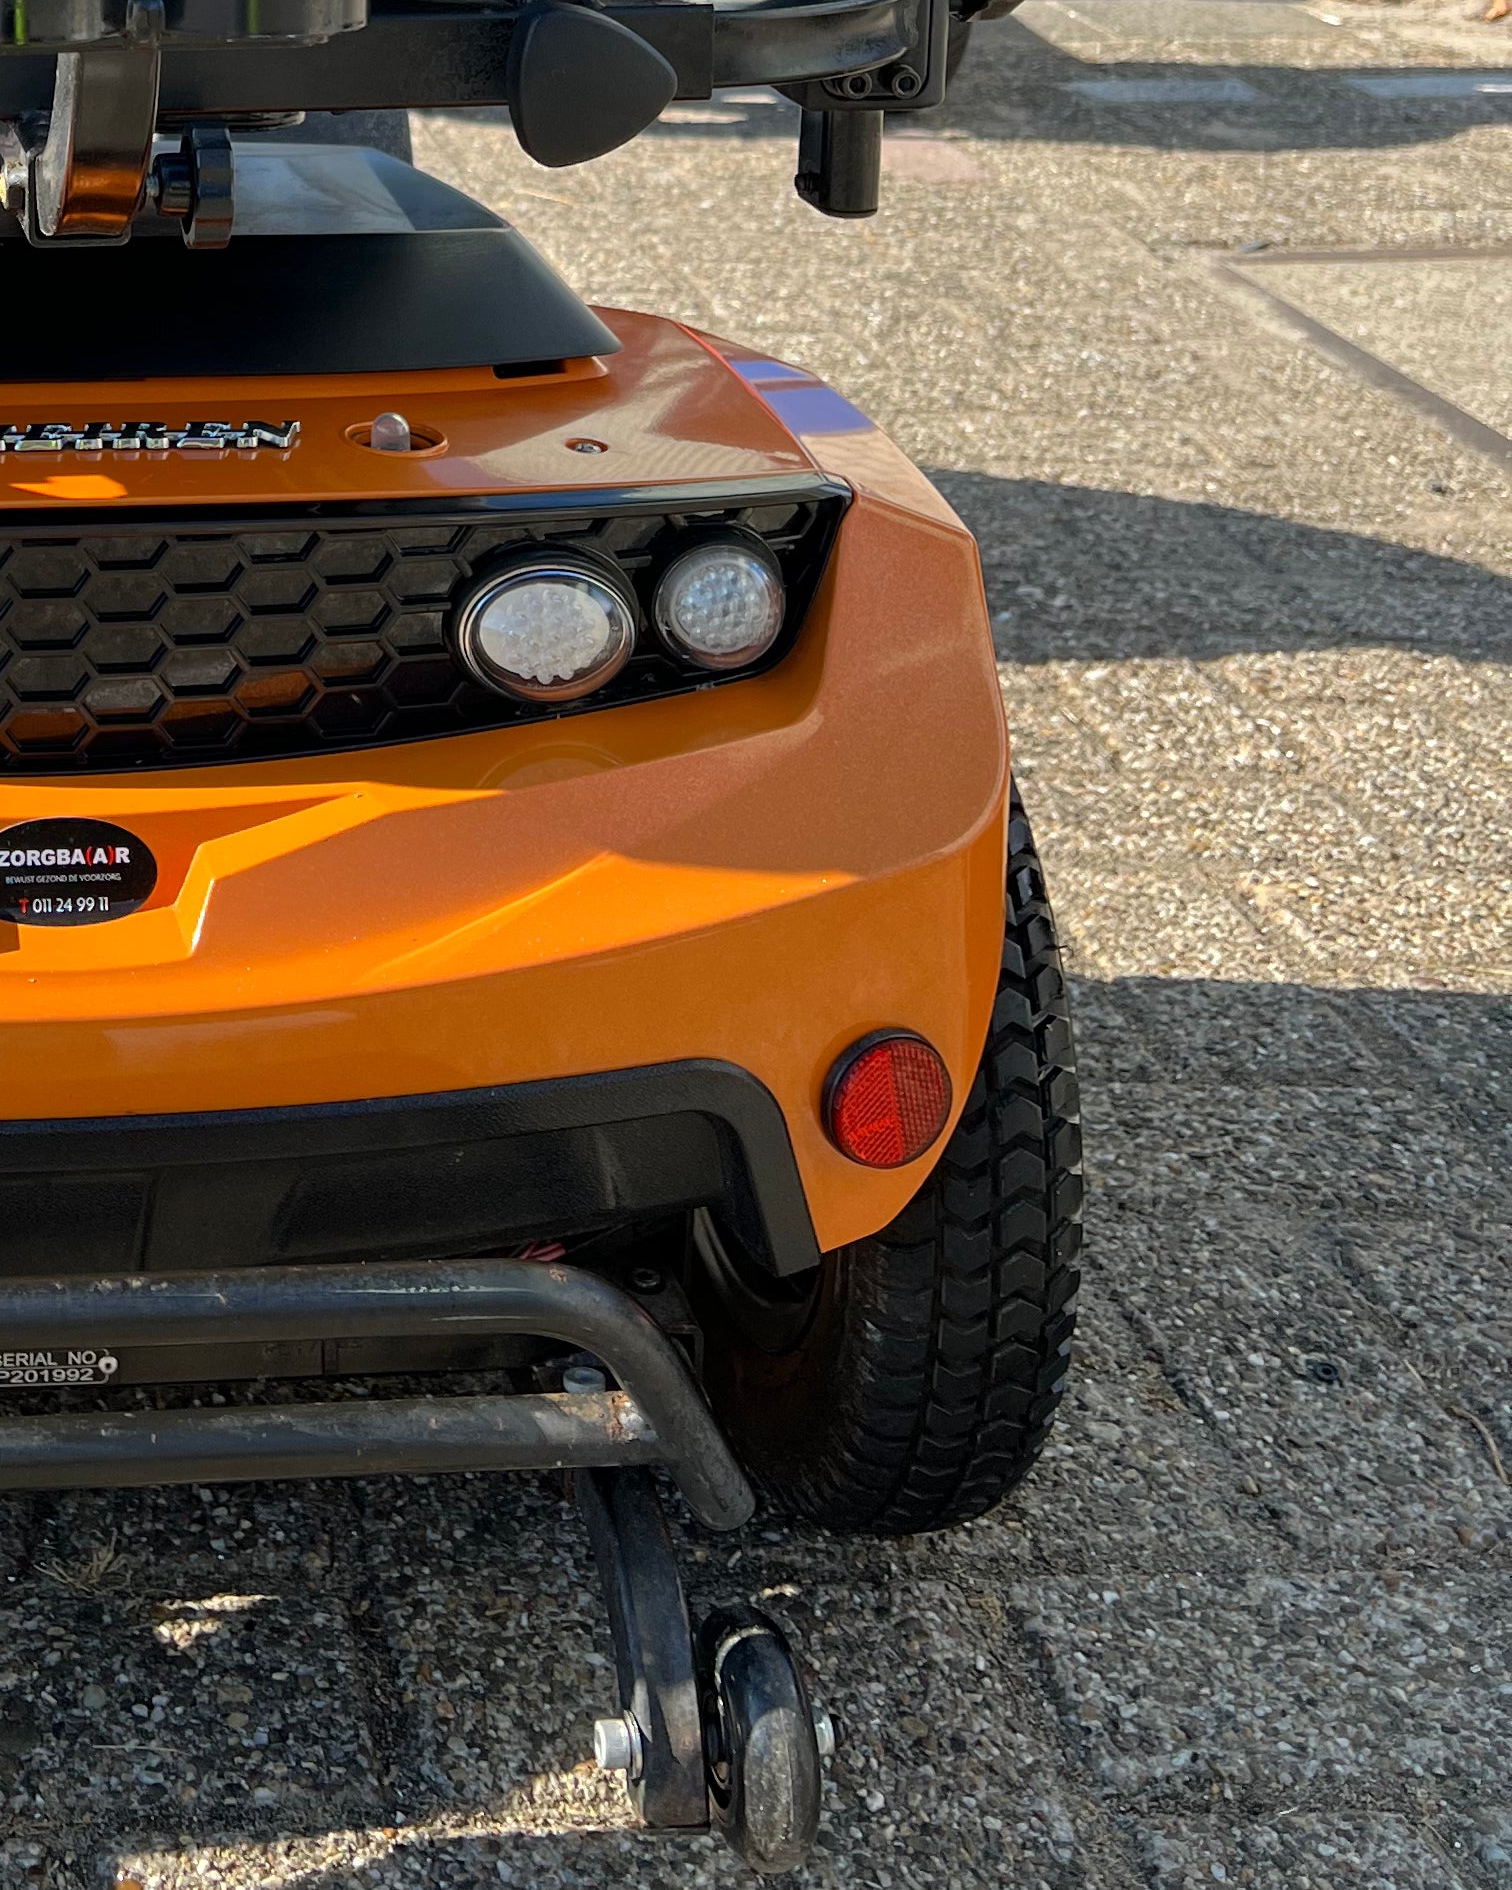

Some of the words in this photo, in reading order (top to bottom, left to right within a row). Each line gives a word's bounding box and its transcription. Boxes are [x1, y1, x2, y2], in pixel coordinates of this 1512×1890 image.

[19, 898, 29, 914] T
[32, 898, 52, 913] 011
[56, 897, 73, 913] 24
[77, 896, 95, 912] 99
[98, 896, 109, 911] 11
[67, 1350, 97, 1365] NO
